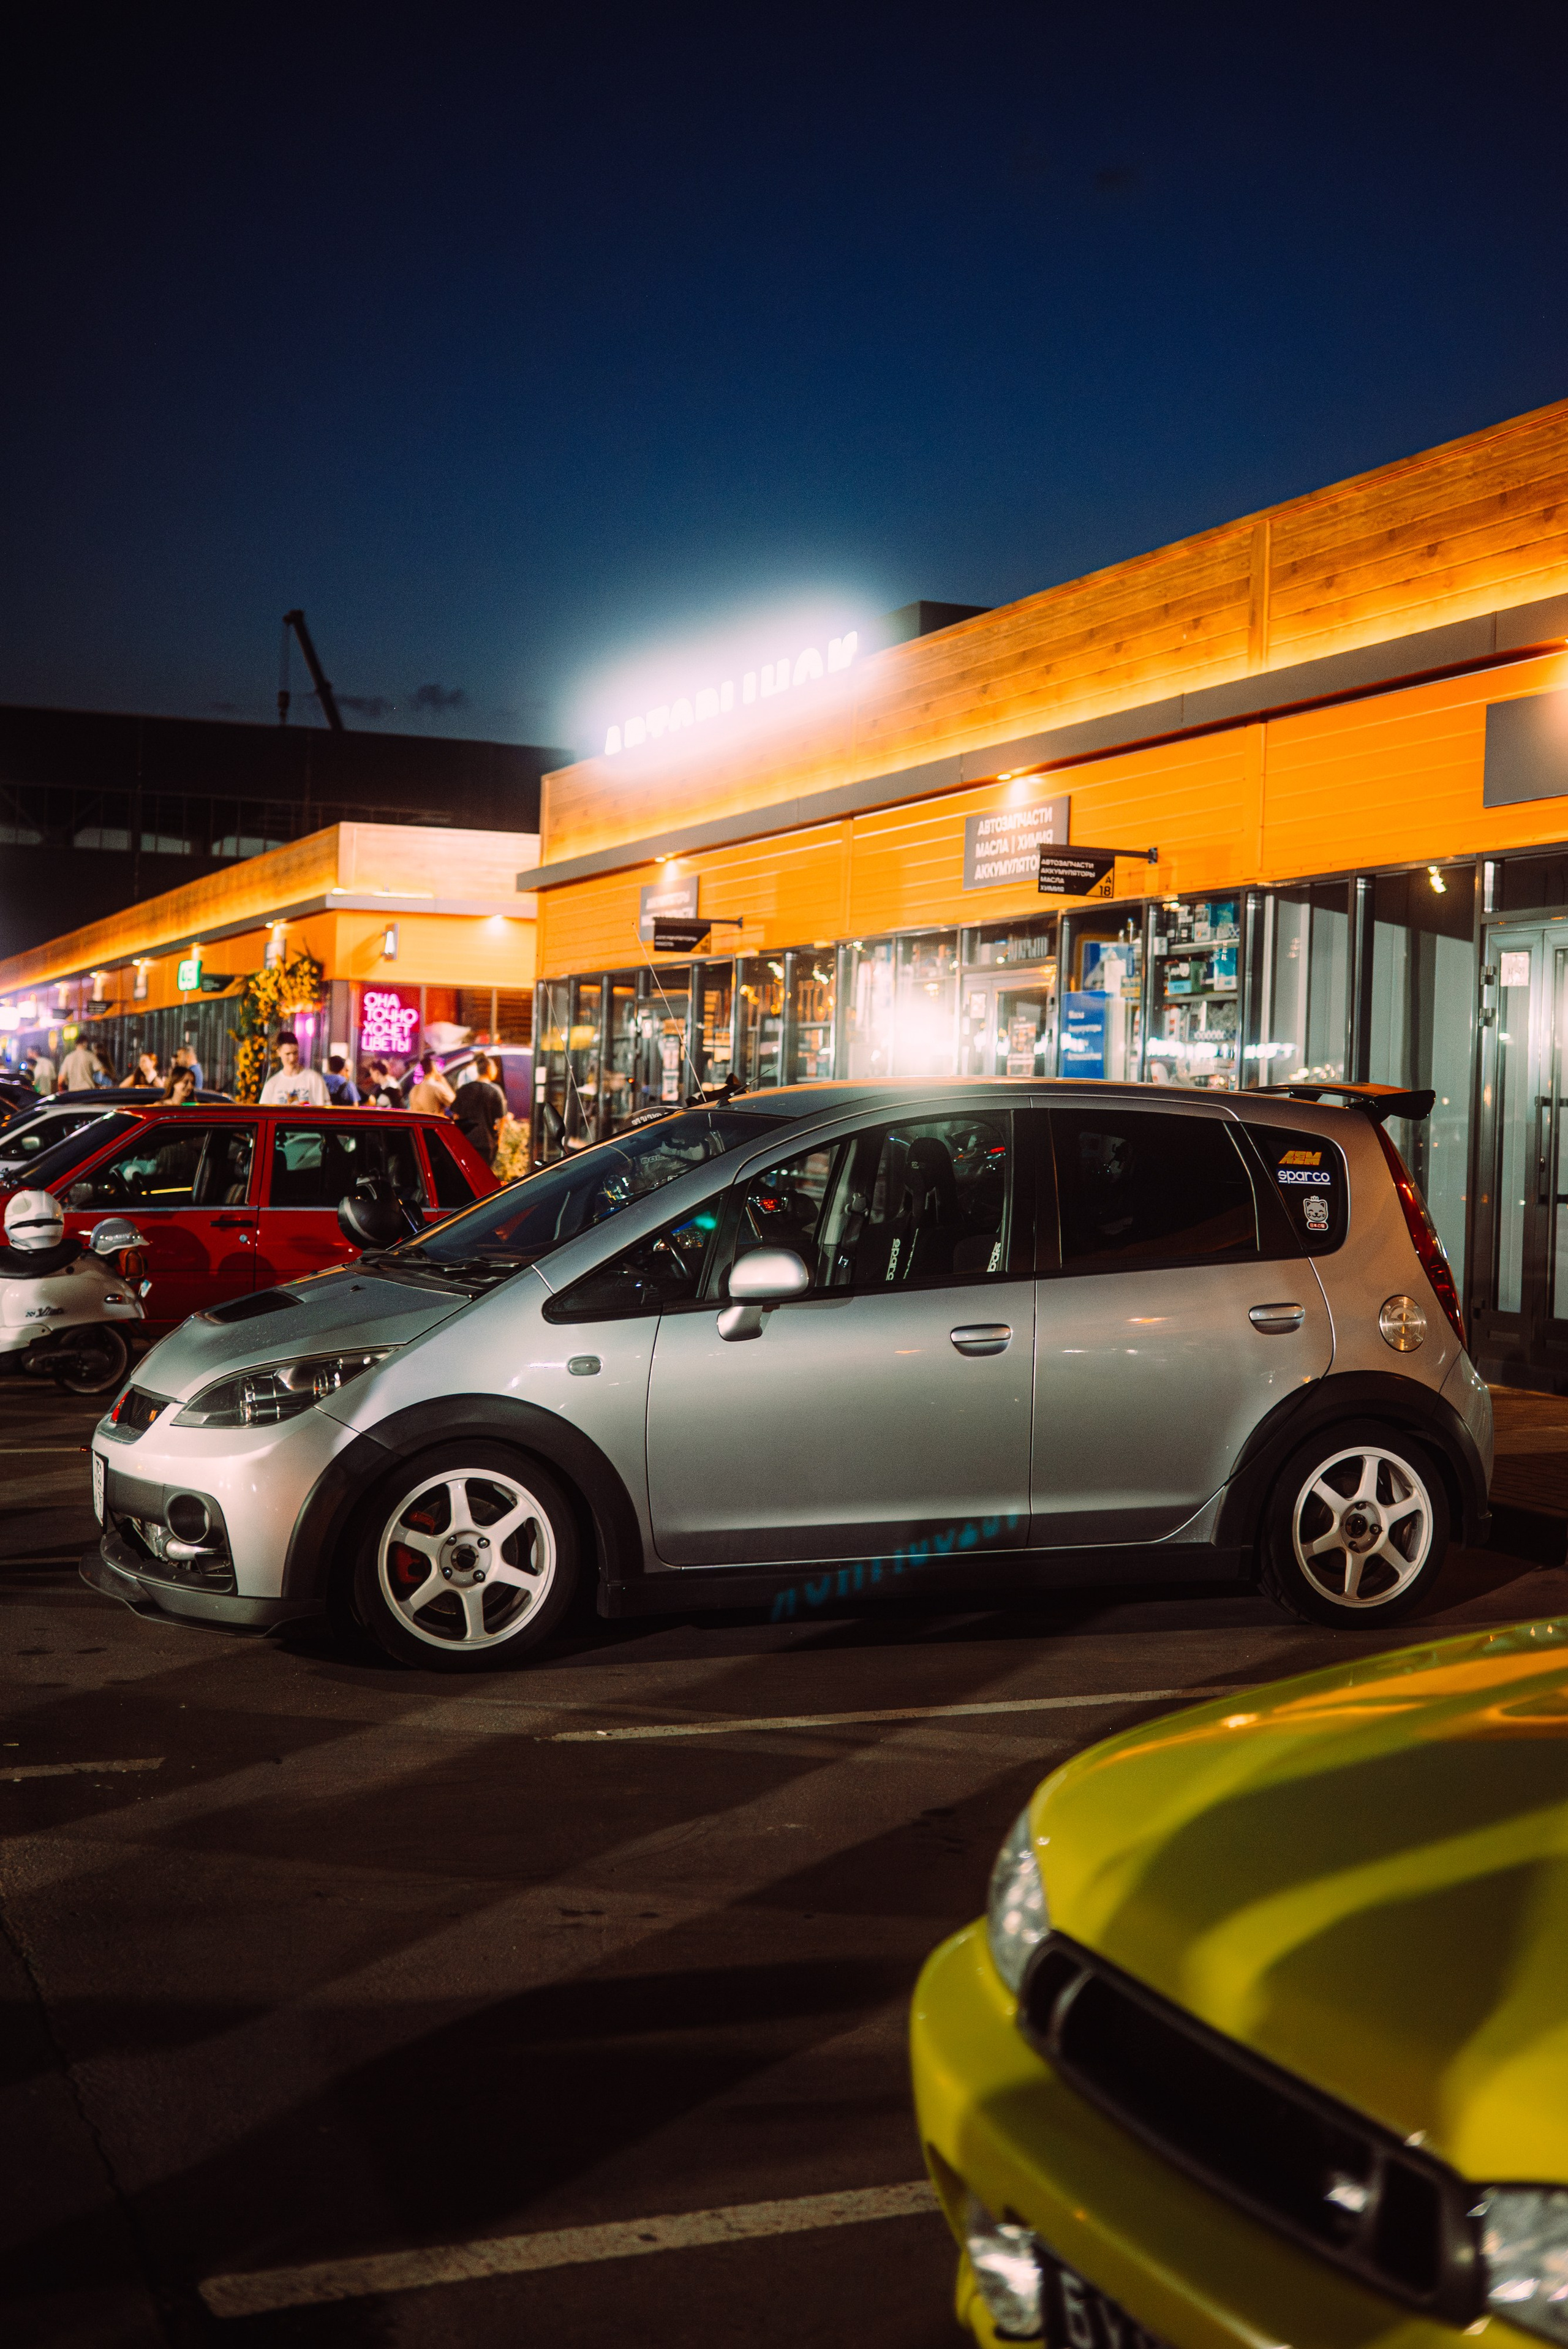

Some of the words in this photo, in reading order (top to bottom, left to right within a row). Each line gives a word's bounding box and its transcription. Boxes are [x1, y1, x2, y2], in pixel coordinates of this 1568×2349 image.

[977, 807, 1053, 835] АВТОЗАПЧАСТИ
[975, 839, 1009, 858] МАСЛА
[1017, 829, 1054, 850] ХИМИЯ
[974, 854, 1040, 880] АККУМУЛЯТО
[1041, 859, 1095, 869] АВТОЗАПЧАСТИ
[1041, 867, 1096, 878] АККУМУЛЯТОРЫ
[1099, 885, 1111, 896] 18
[364, 992, 401, 1008] ОНА
[364, 1006, 419, 1025] ТОЧНО
[362, 1020, 413, 1038] ХОЧЕТ
[361, 1035, 412, 1052] ЦВЕТЫ
[1278, 1150, 1322, 1166] AEM
[1278, 1171, 1331, 1185] sparco
